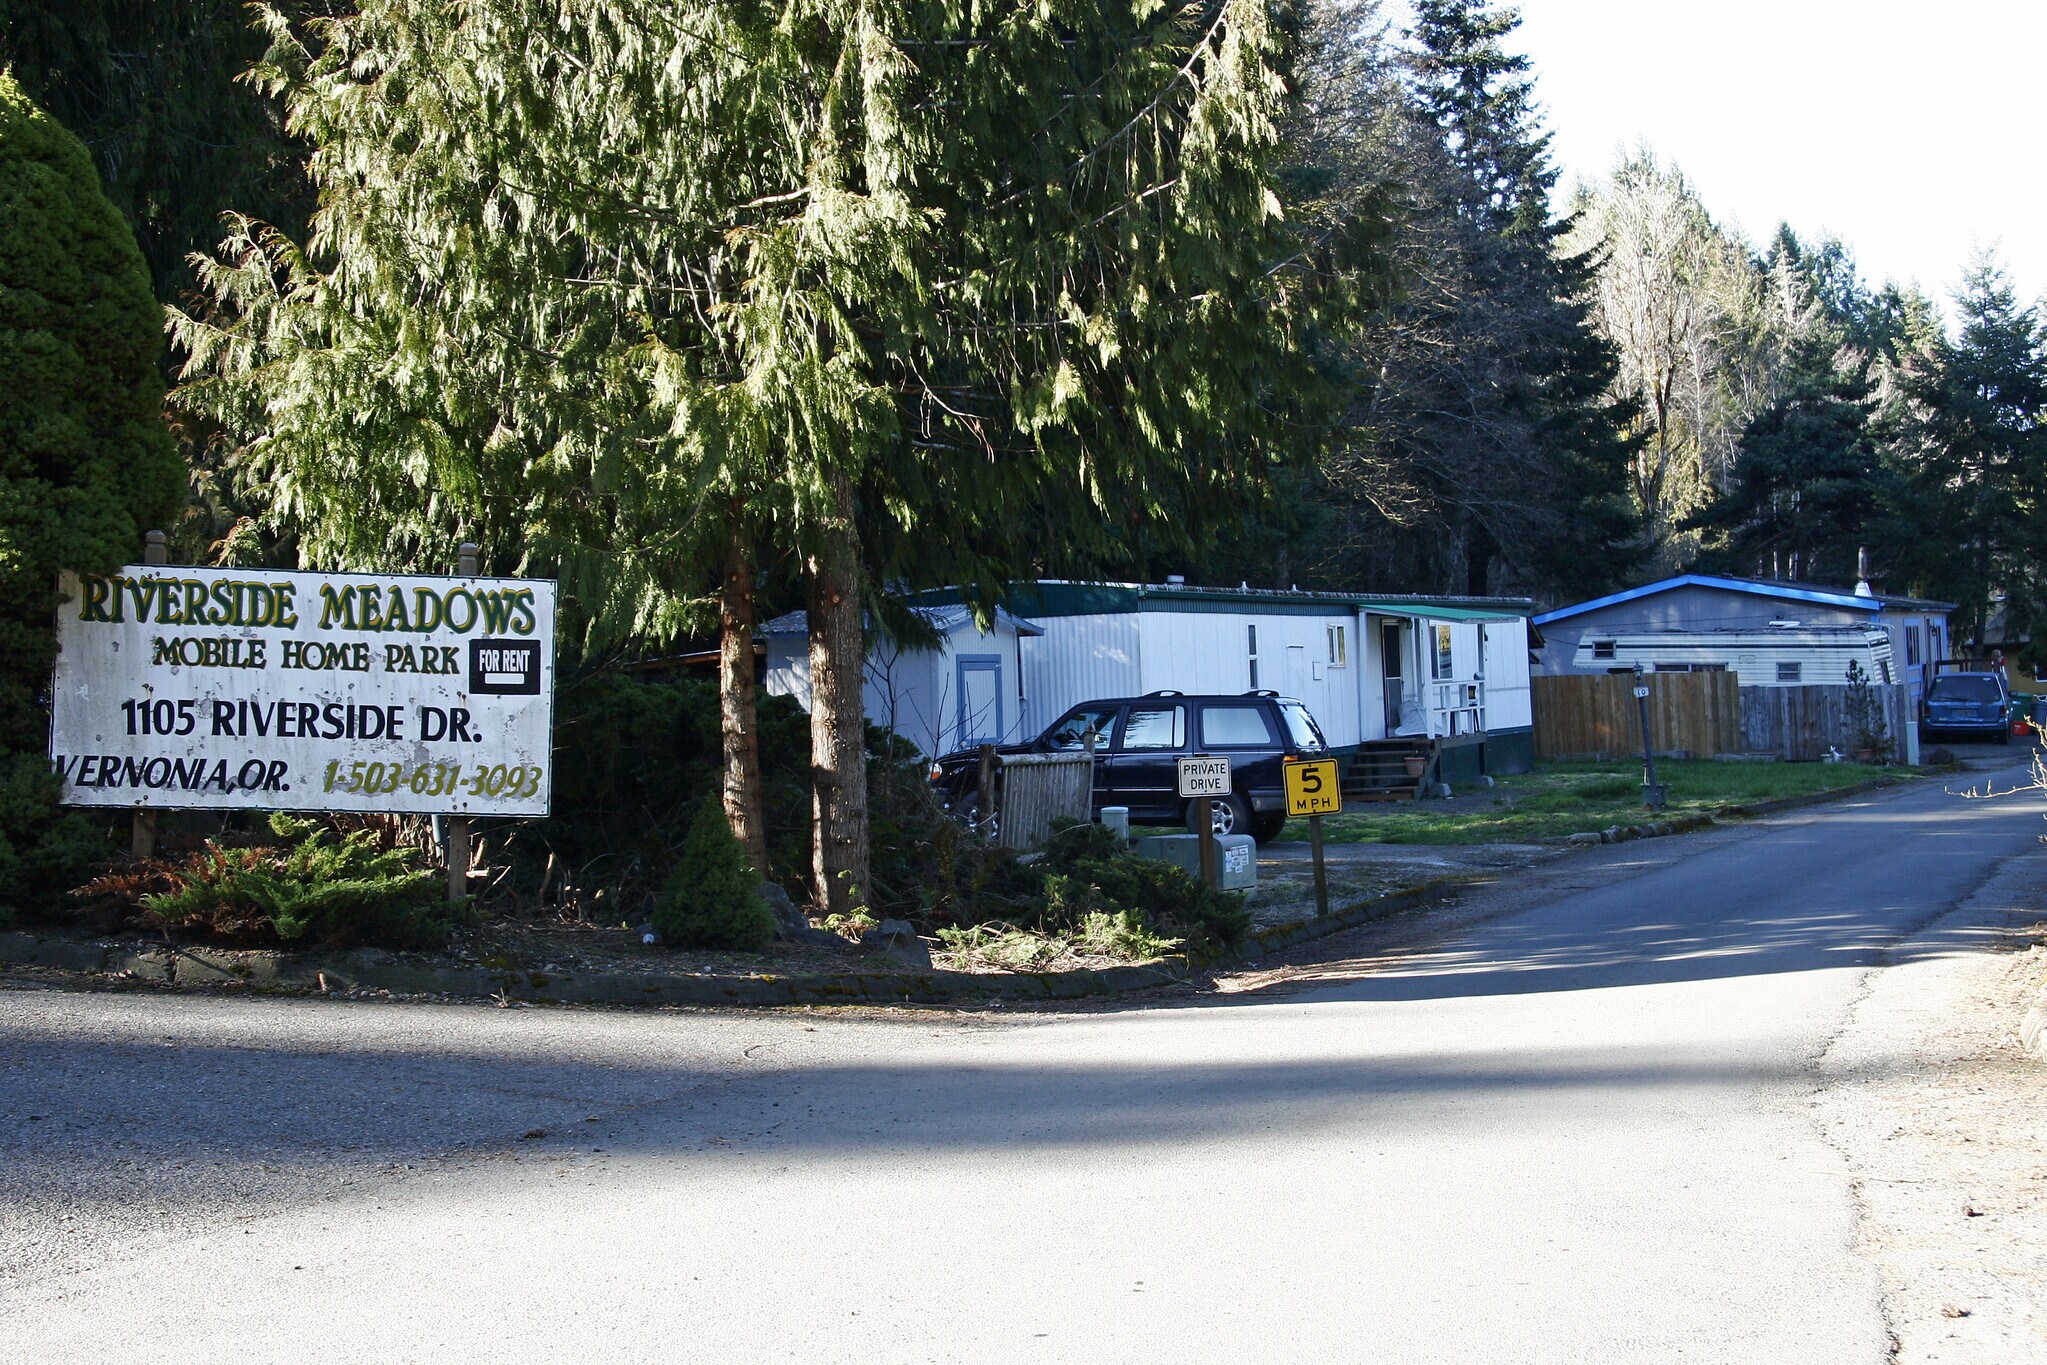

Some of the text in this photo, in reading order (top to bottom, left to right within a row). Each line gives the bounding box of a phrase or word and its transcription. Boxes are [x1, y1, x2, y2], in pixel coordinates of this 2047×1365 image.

[79, 575, 536, 636] RIVERSIDE MEADOWS
[153, 636, 460, 675] MOBILE HOME PARK
[479, 649, 530, 673] FOR RENT
[121, 699, 483, 743] 1105 RIVERSIDE DR.
[322, 760, 543, 799] 1-503-631-3093
[1183, 763, 1226, 775] PRIVATE
[1190, 778, 1221, 790] DRIVE
[1301, 767, 1322, 793] 5
